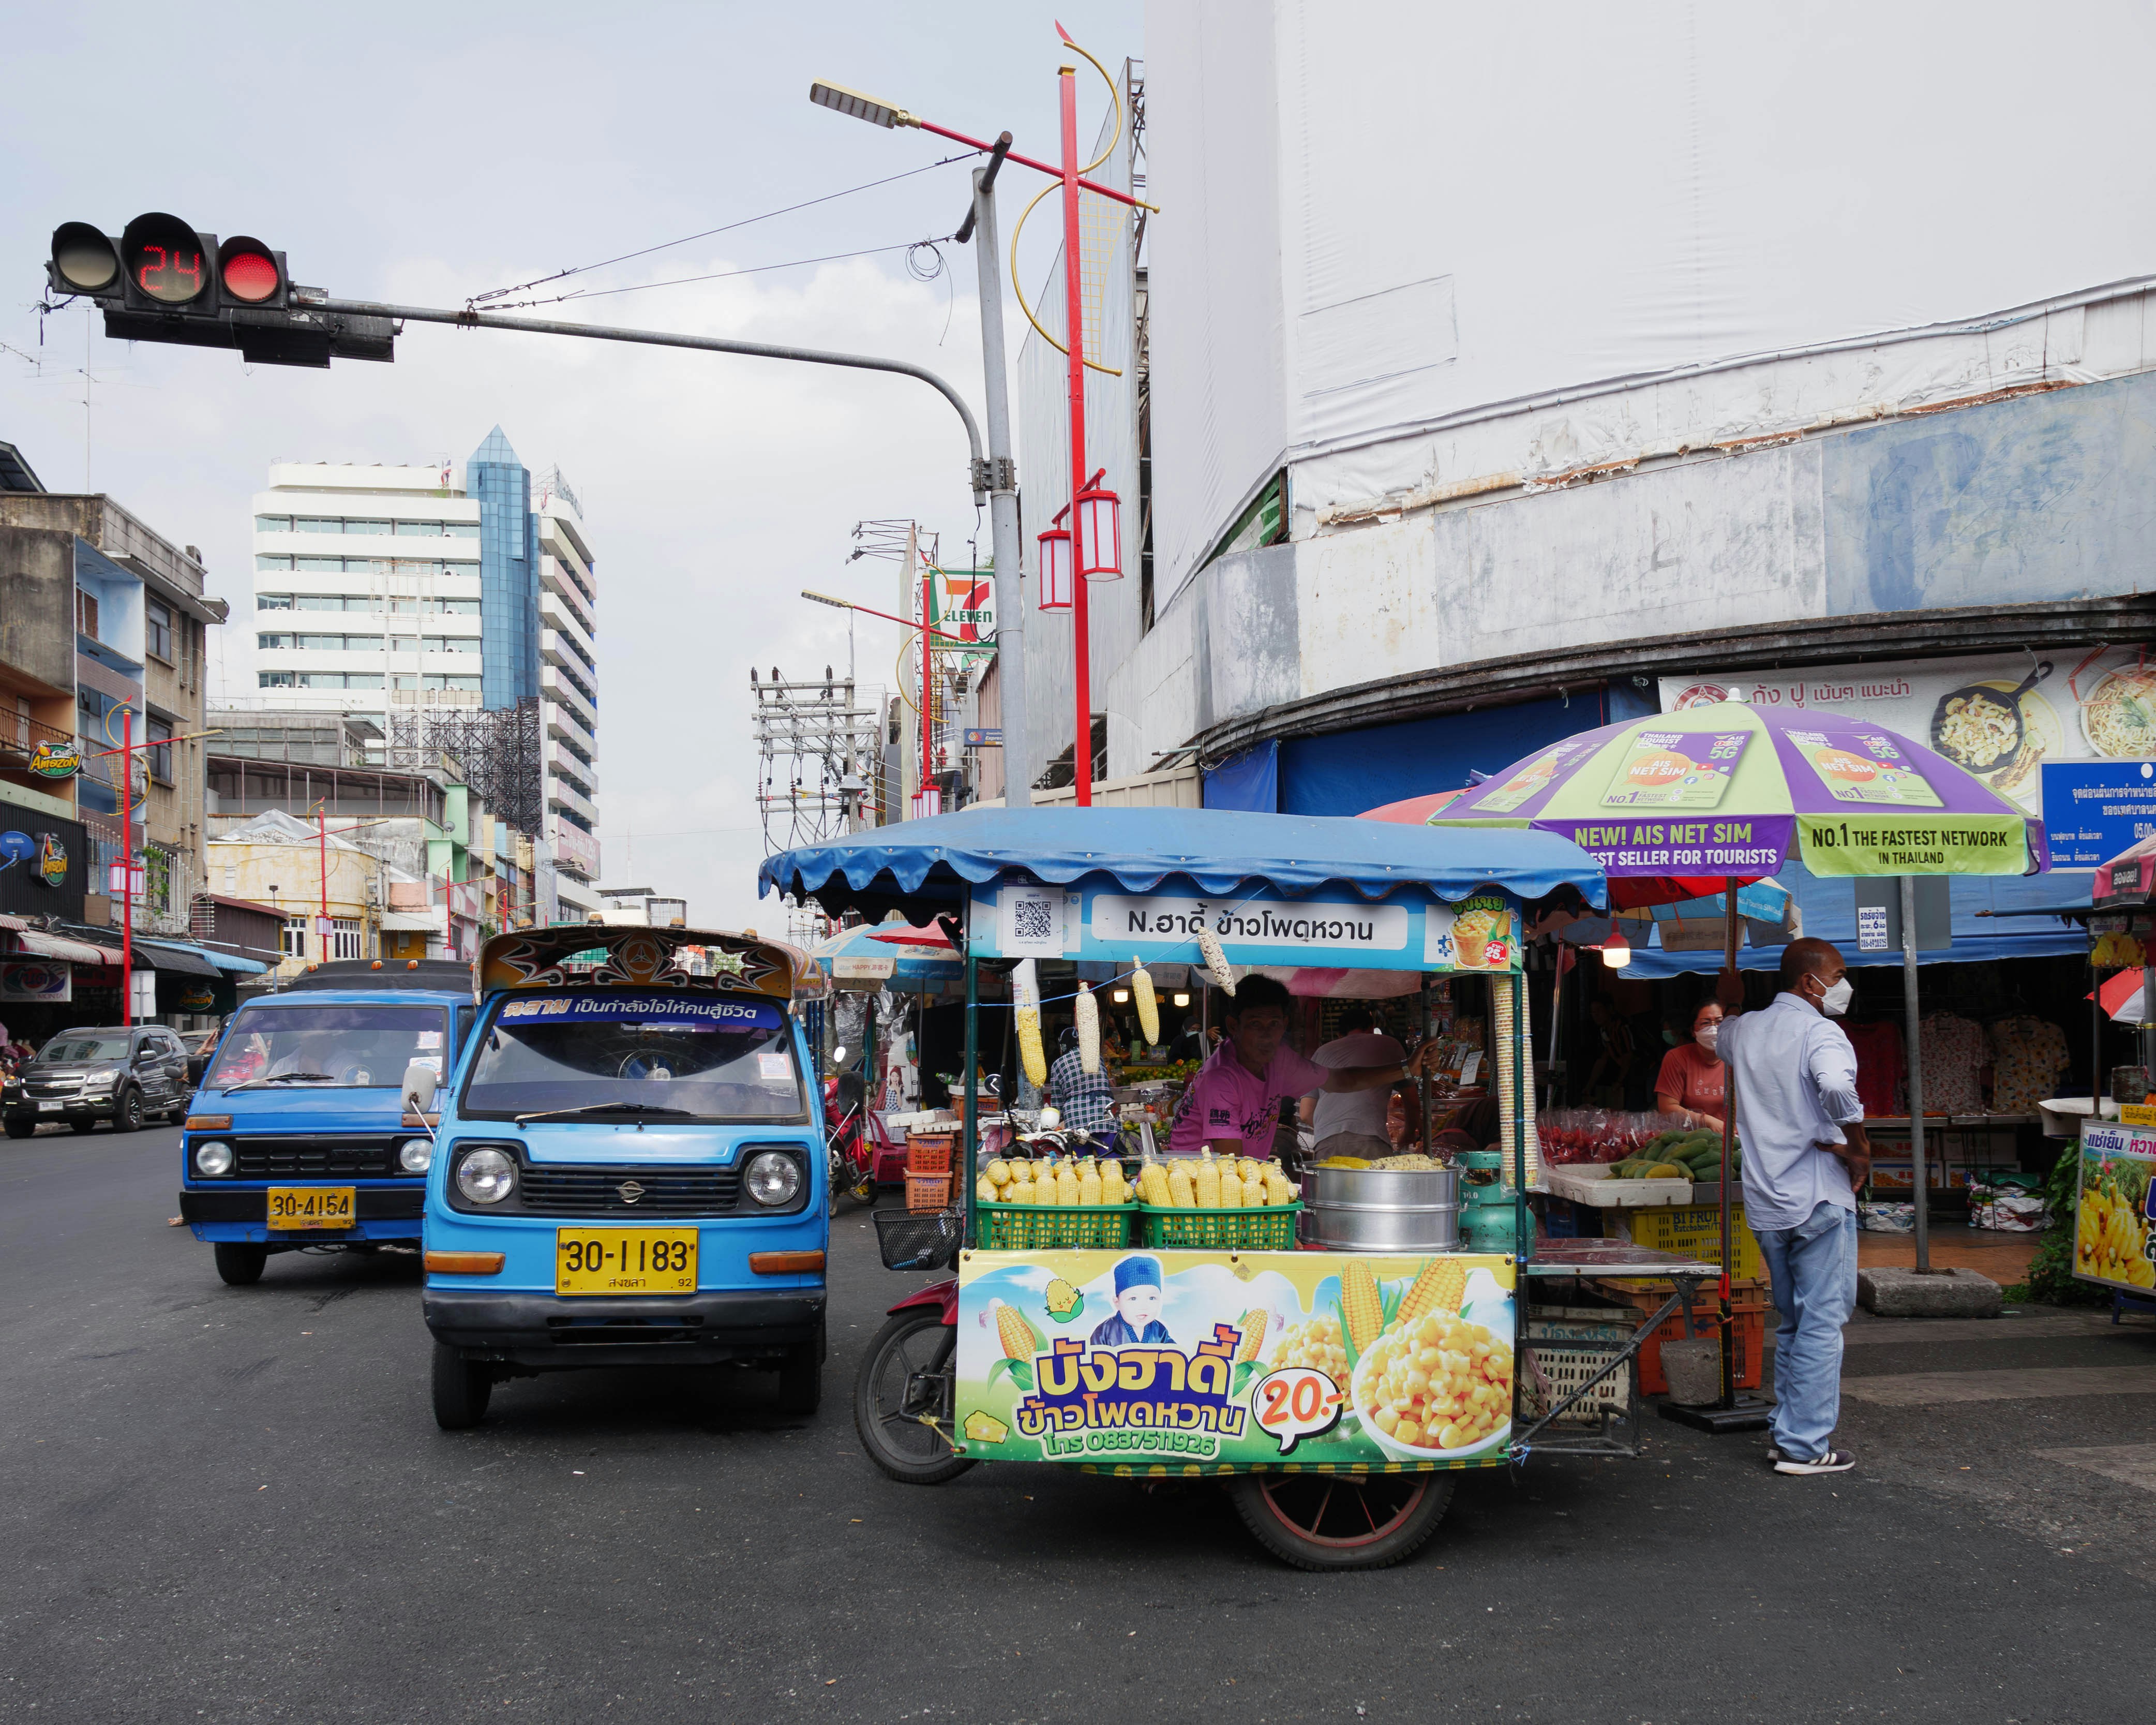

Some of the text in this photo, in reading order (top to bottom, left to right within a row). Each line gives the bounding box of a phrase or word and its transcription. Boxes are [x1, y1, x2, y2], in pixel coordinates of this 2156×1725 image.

[139, 244, 201, 292] 24
[1790, 682, 1804, 708] ปู
[1814, 683, 1854, 702] เน้นๆ
[1862, 678, 1910, 697] แนะนำ
[1708, 747, 1739, 760] 5G
[1868, 747, 1900, 759] 5G
[1630, 767, 1686, 776] NET SIM
[1821, 762, 1875, 774] NET SIM
[1606, 791, 1640, 804] NO.1
[1575, 823, 1752, 846] NEW! AIS NET SIM
[1813, 823, 2007, 848] NO.1 THE FASTEST NETWORK
[1618, 850, 1669, 867] SELLER
[1673, 850, 1701, 865] FOR
[1703, 848, 1777, 865] TOURISTS
[1878, 852, 1944, 865] IN THAILAND
[1450, 896, 1505, 915] อบเนย
[1217, 910, 1373, 941] ข้าวโพดหวาน
[1874, 920, 1878, 929] 6
[502, 999, 757, 1019] ฉลาม เป็นกำลังใจให้คนสู้ชีวิต
[2088, 1131, 2124, 1151] แช่เย็น
[273, 1195, 349, 1216] 30-4154
[565, 1240, 687, 1272] 30-1183
[608, 1278, 692, 1287] สงขลา 92
[1017, 1393, 1247, 1436] ข้าวโพดหวาน
[1086, 1430, 1216, 1455] 0837511926
